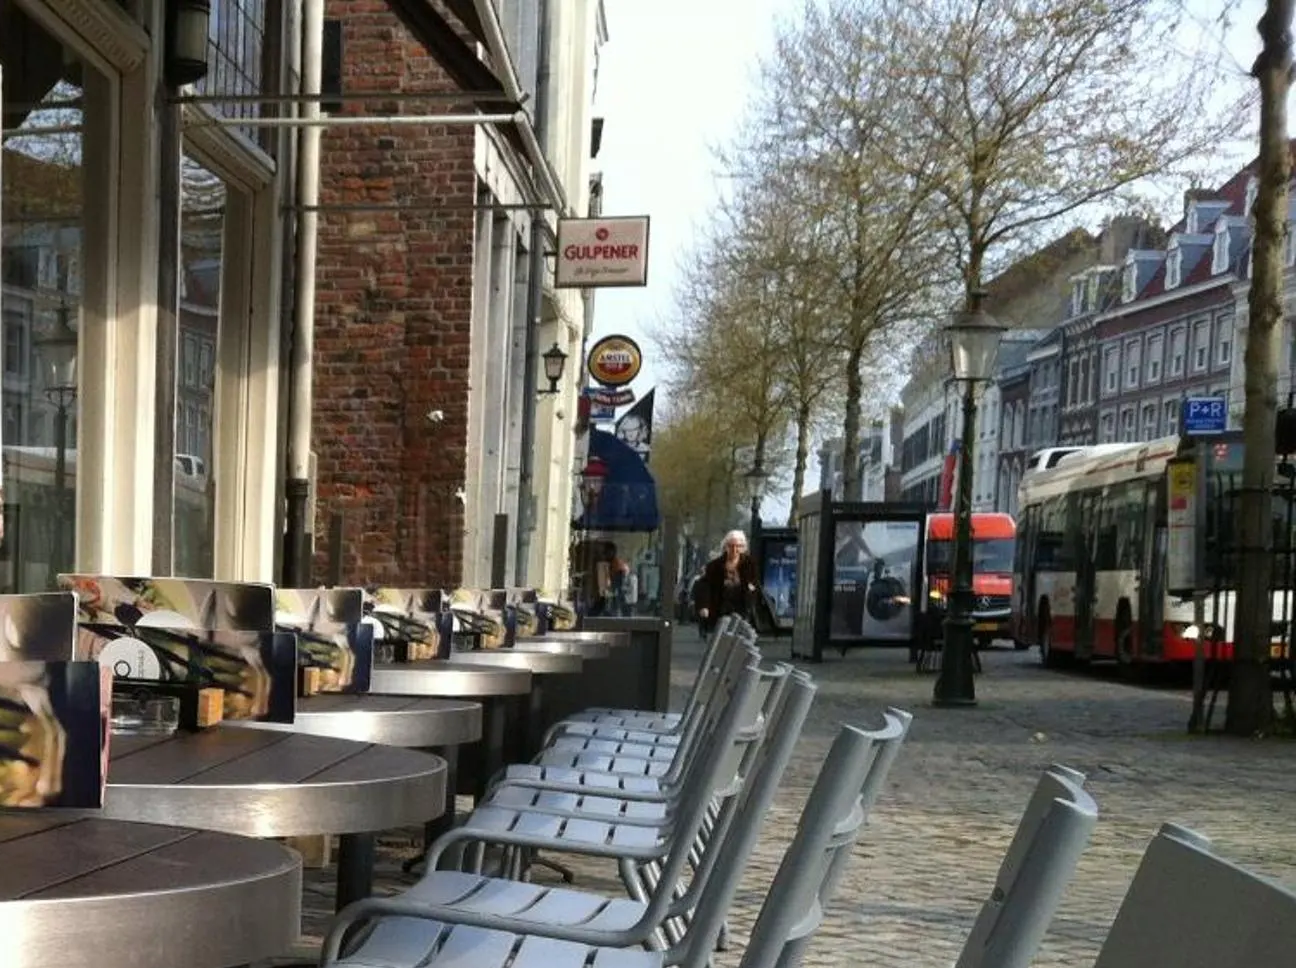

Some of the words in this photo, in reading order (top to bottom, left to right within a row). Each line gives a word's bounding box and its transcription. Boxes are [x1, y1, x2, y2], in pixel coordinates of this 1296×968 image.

[564, 244, 638, 260] GULPENER
[599, 353, 630, 362] AMSTEL
[1189, 402, 1222, 417] P+R
